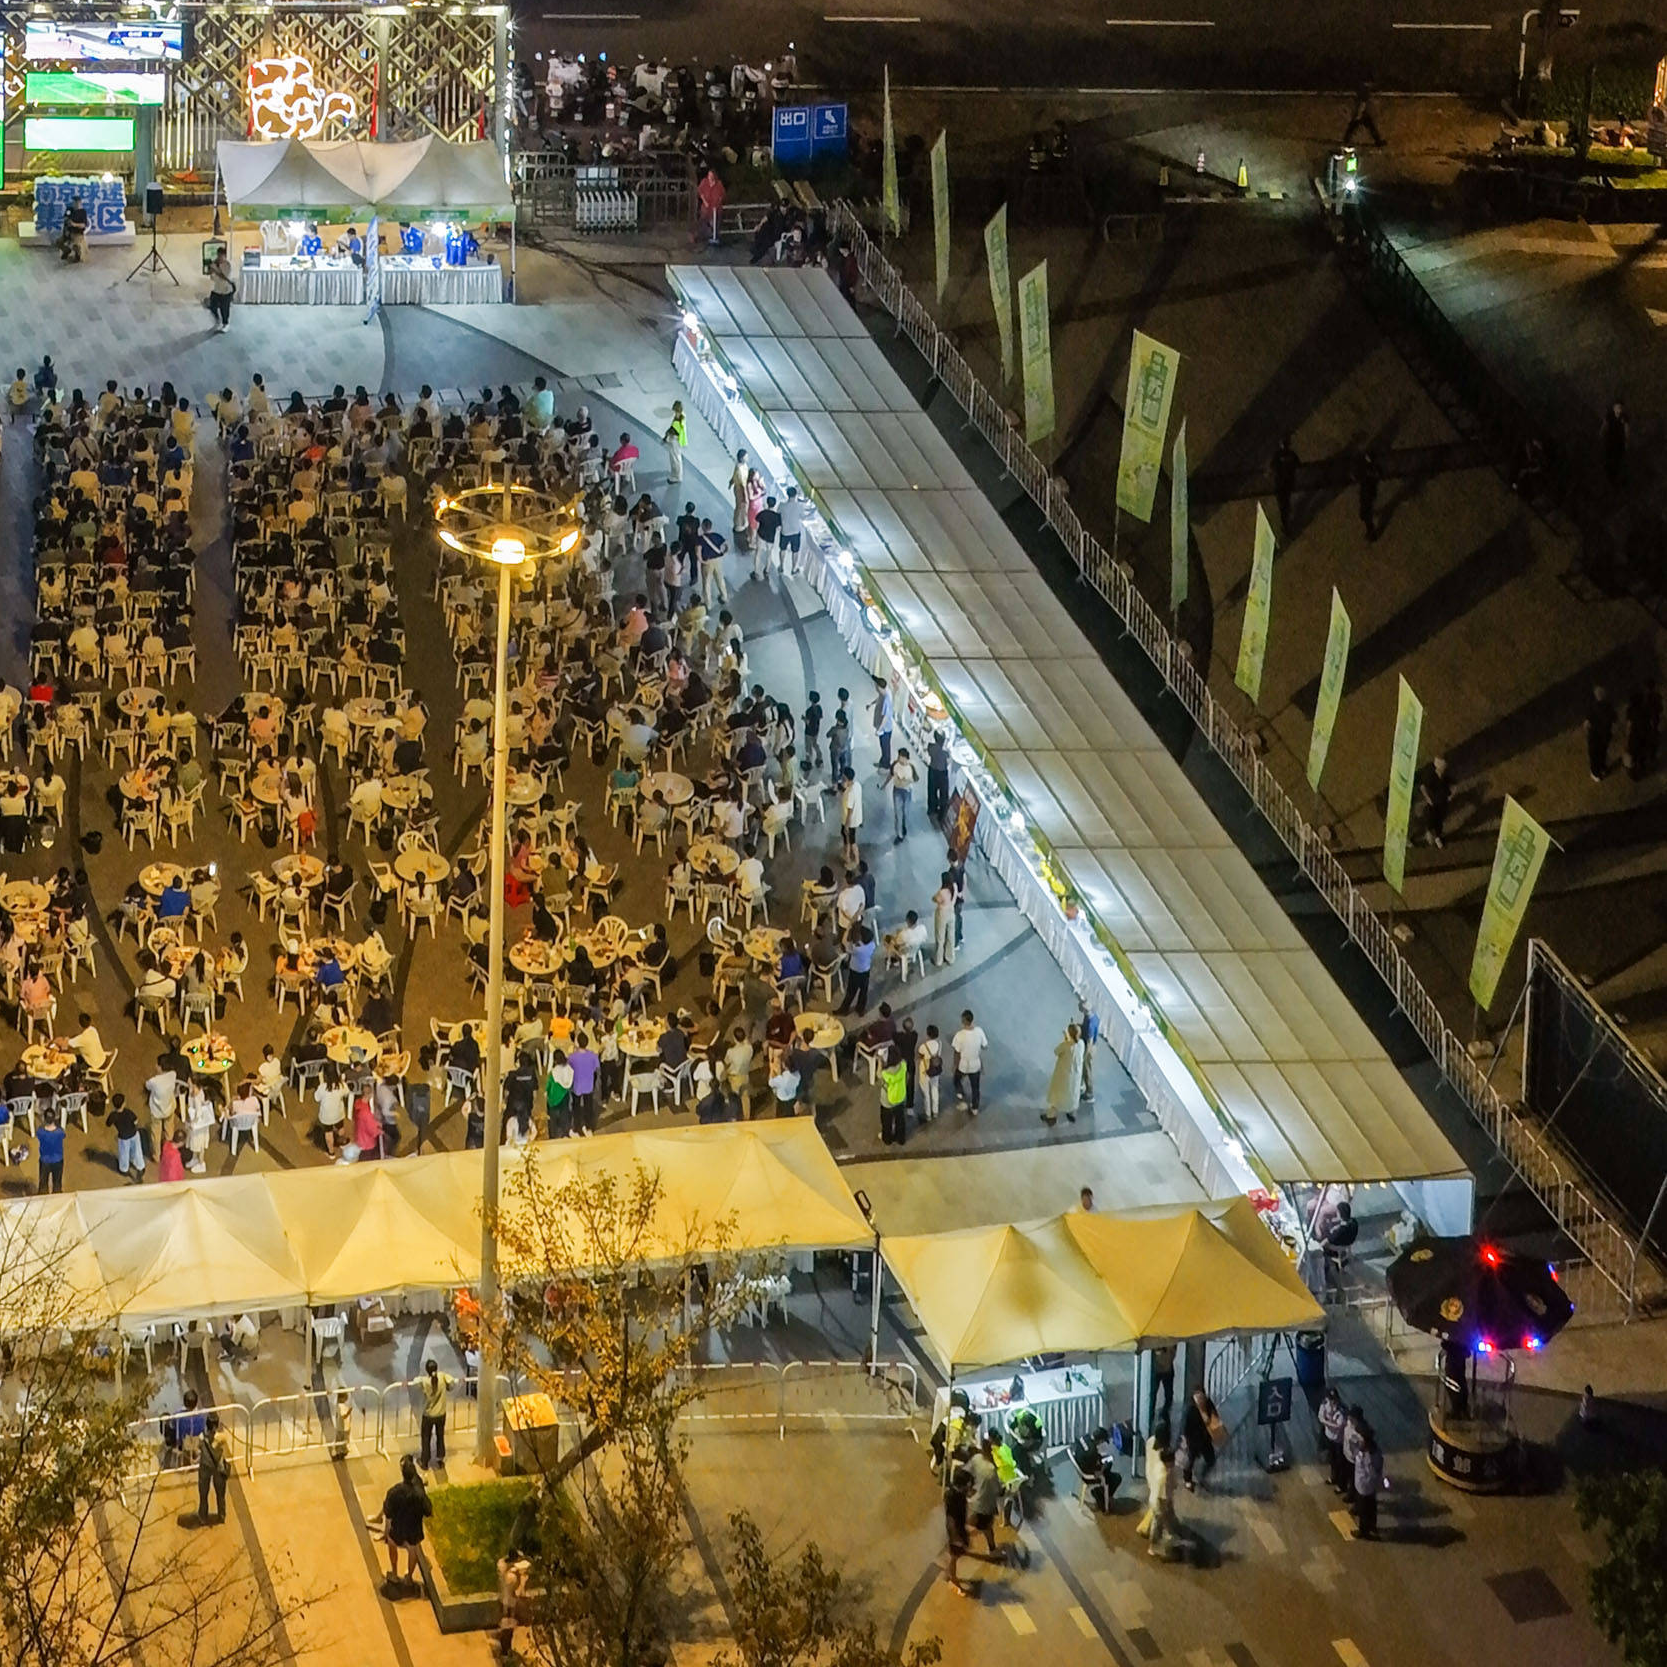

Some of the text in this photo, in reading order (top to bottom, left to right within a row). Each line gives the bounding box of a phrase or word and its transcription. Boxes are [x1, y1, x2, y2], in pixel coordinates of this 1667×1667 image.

[780, 112, 806, 126] 出口
[36, 180, 124, 203] 南京球迷
